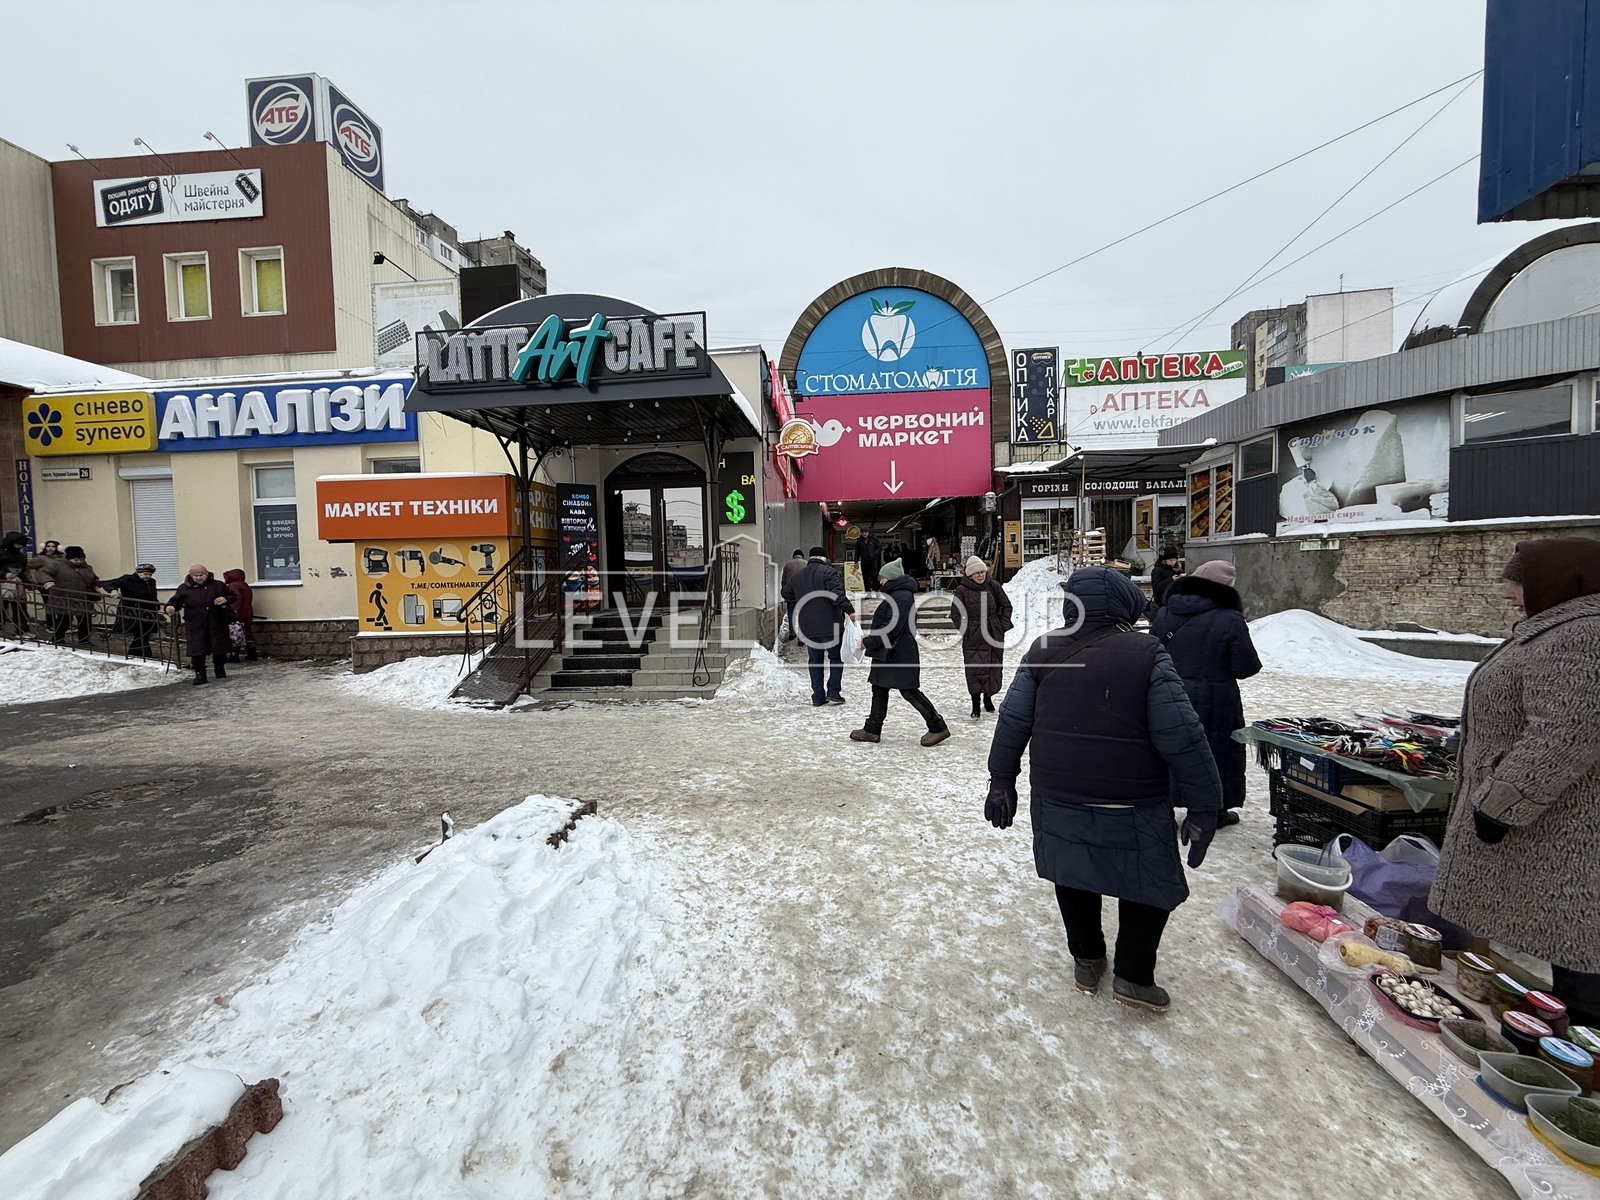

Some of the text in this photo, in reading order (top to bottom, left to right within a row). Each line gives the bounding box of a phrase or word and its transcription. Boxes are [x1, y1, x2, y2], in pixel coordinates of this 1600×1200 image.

[260, 105, 300, 125] АТБ
[340, 125, 372, 158] АТБ
[184, 183, 229, 198] Швейна
[184, 198, 245, 212] майстерня
[511, 312, 612, 387] Art
[604, 319, 699, 373] CAFE
[1098, 353, 1224, 381] АПТЕКА
[1016, 352, 1029, 441] ОПТИКА
[1044, 366, 1055, 418] ЛІКАР
[1101, 388, 1210, 412] АПТЕКА
[158, 384, 406, 440] АНАЛІЗИ
[75, 424, 146, 447] synevo
[858, 429, 953, 448] МАРКЕТ
[80, 469, 89, 478] 26
[1032, 483, 1069, 493] ГОРІХИ
[1084, 480, 1139, 491] СОЛОДОЩІ
[325, 499, 498, 518] МАРКЕТ ТЕХНІКИ
